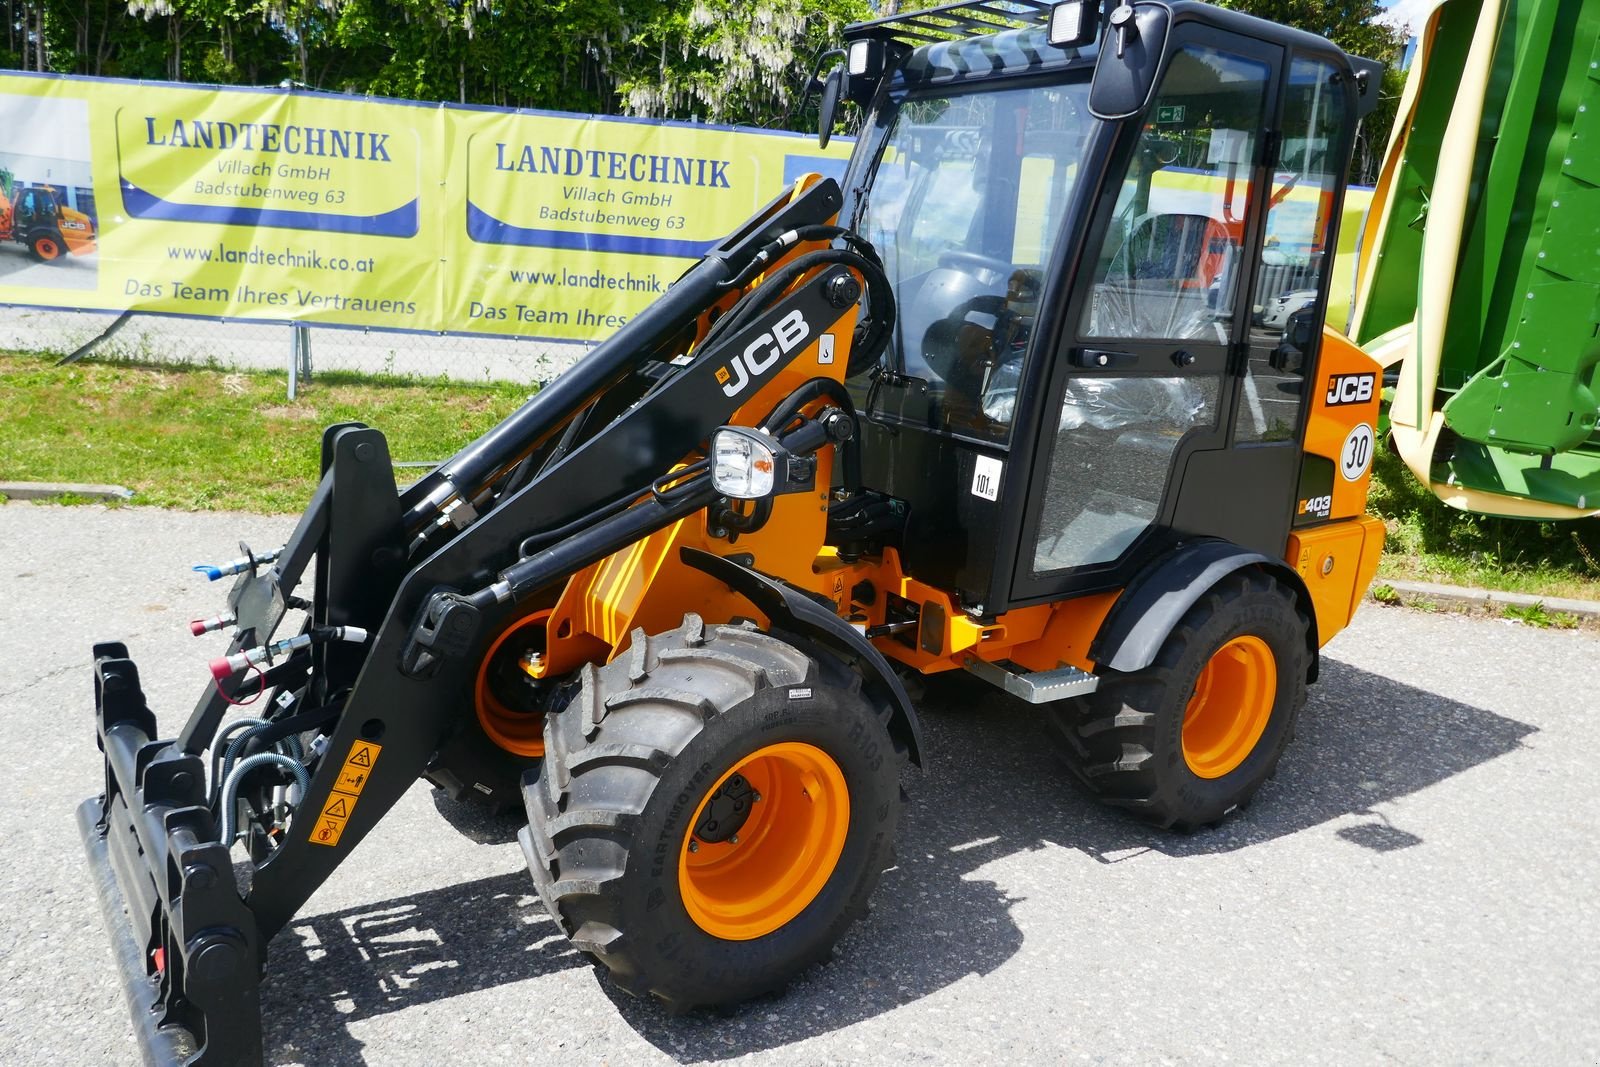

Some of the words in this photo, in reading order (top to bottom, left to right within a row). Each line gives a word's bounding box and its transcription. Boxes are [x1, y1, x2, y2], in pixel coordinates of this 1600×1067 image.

[144, 117, 392, 162] LANDTECHNIK
[217, 160, 272, 177] Villach
[277, 164, 331, 181] GmbH
[495, 143, 731, 188] LANDTECHNIK
[194, 180, 320, 205] Badstubenweg
[325, 190, 346, 204] 63
[563, 186, 615, 203] Villach
[621, 191, 673, 207] GmbH
[539, 206, 661, 231] Badstubenweg
[666, 215, 686, 230] 63
[167, 243, 375, 273] www.landtechnik.co.at
[124, 279, 163, 297] Das
[171, 281, 230, 302] Team
[237, 284, 288, 306] Ihres
[297, 289, 417, 315] Vertrauens
[469, 301, 507, 320] Das
[515, 304, 569, 325] Team
[576, 308, 627, 329] Ihres
[722, 309, 810, 398] JCB
[1326, 375, 1375, 404] JCB
[1346, 435, 1369, 470] 30
[976, 474, 991, 495] 101
[1305, 495, 1332, 513] 403
[651, 761, 713, 878] EARTHMOVER
